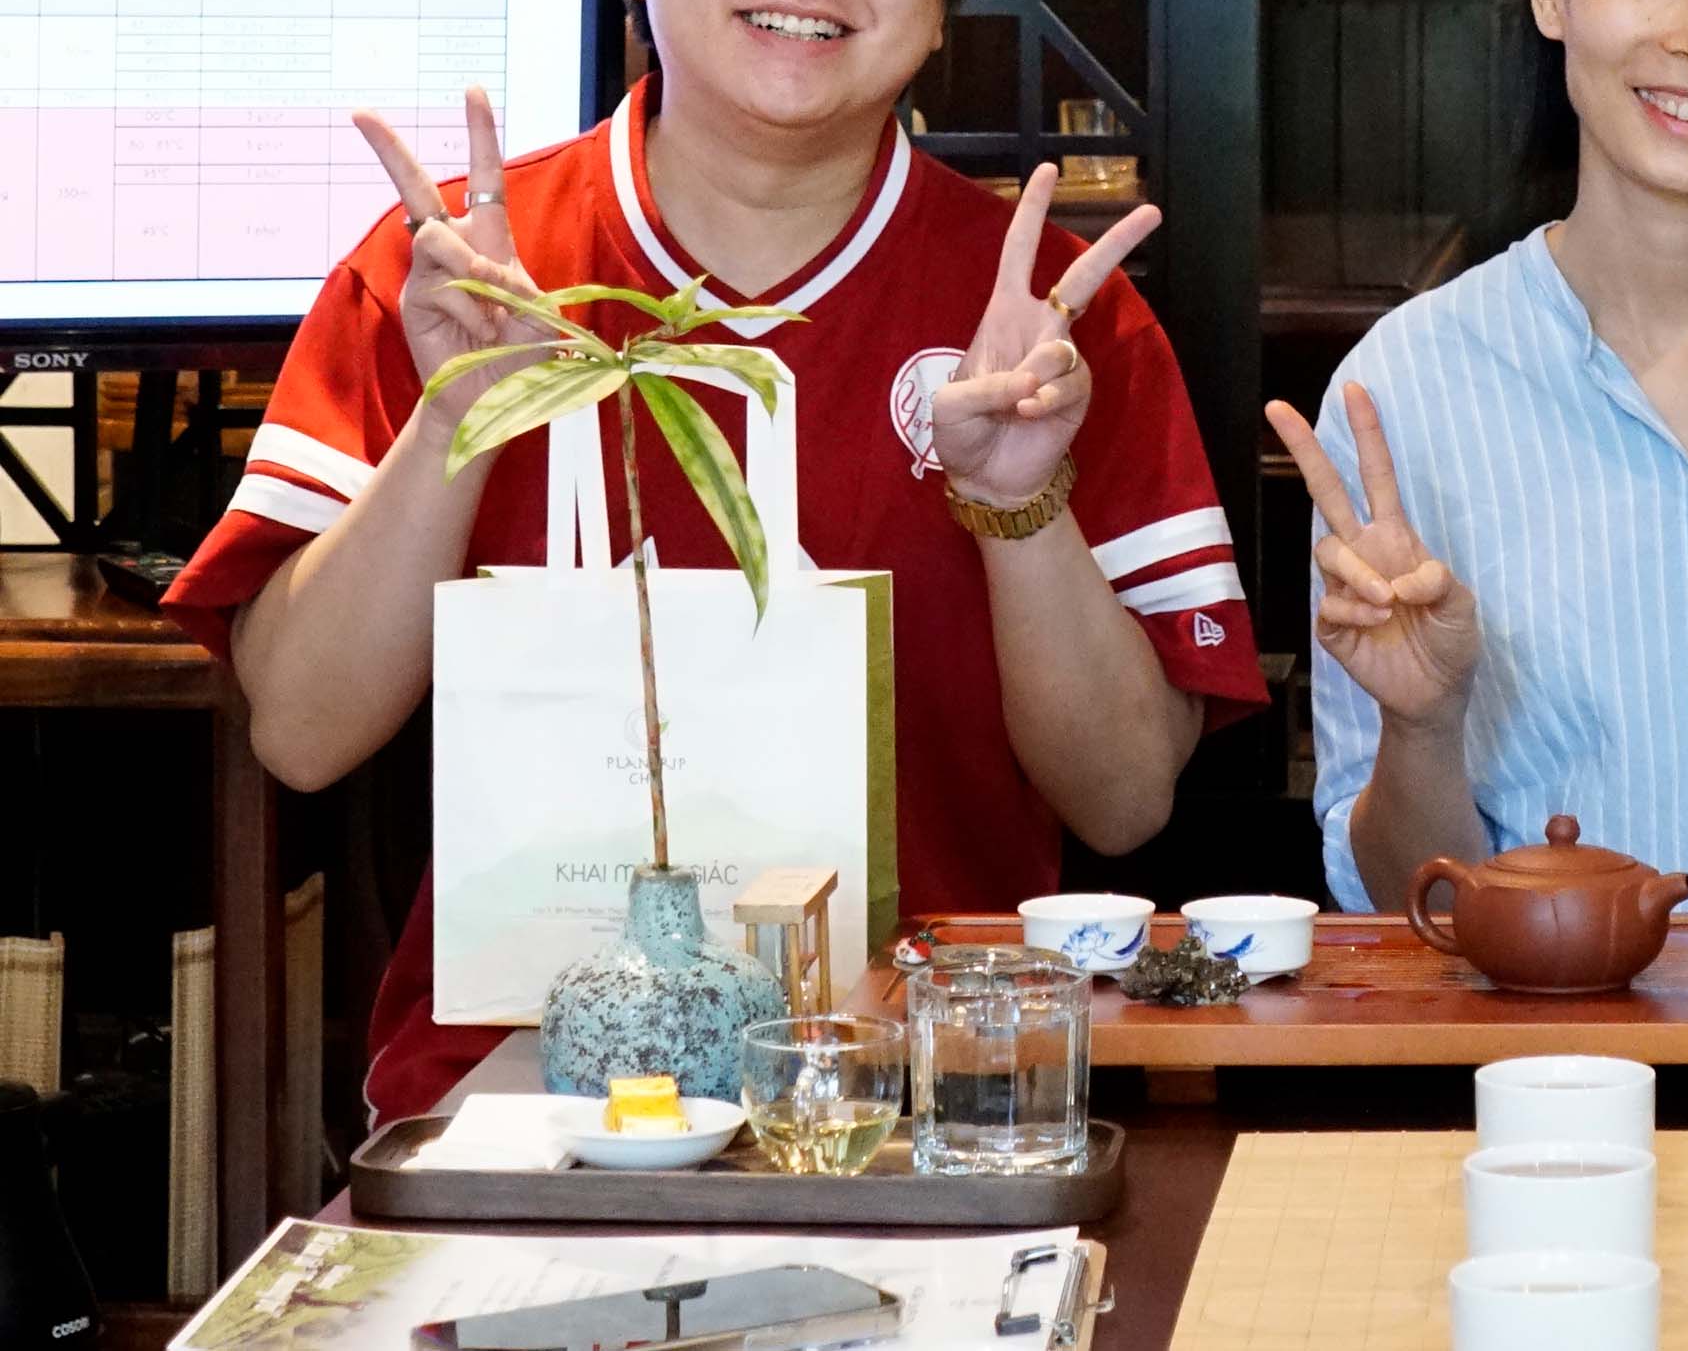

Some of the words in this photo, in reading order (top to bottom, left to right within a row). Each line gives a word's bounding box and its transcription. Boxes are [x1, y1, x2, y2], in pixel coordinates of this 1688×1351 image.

[14, 352, 89, 369] SONY
[607, 756, 687, 771] PLANRIP
[556, 863, 607, 883] KHAI
